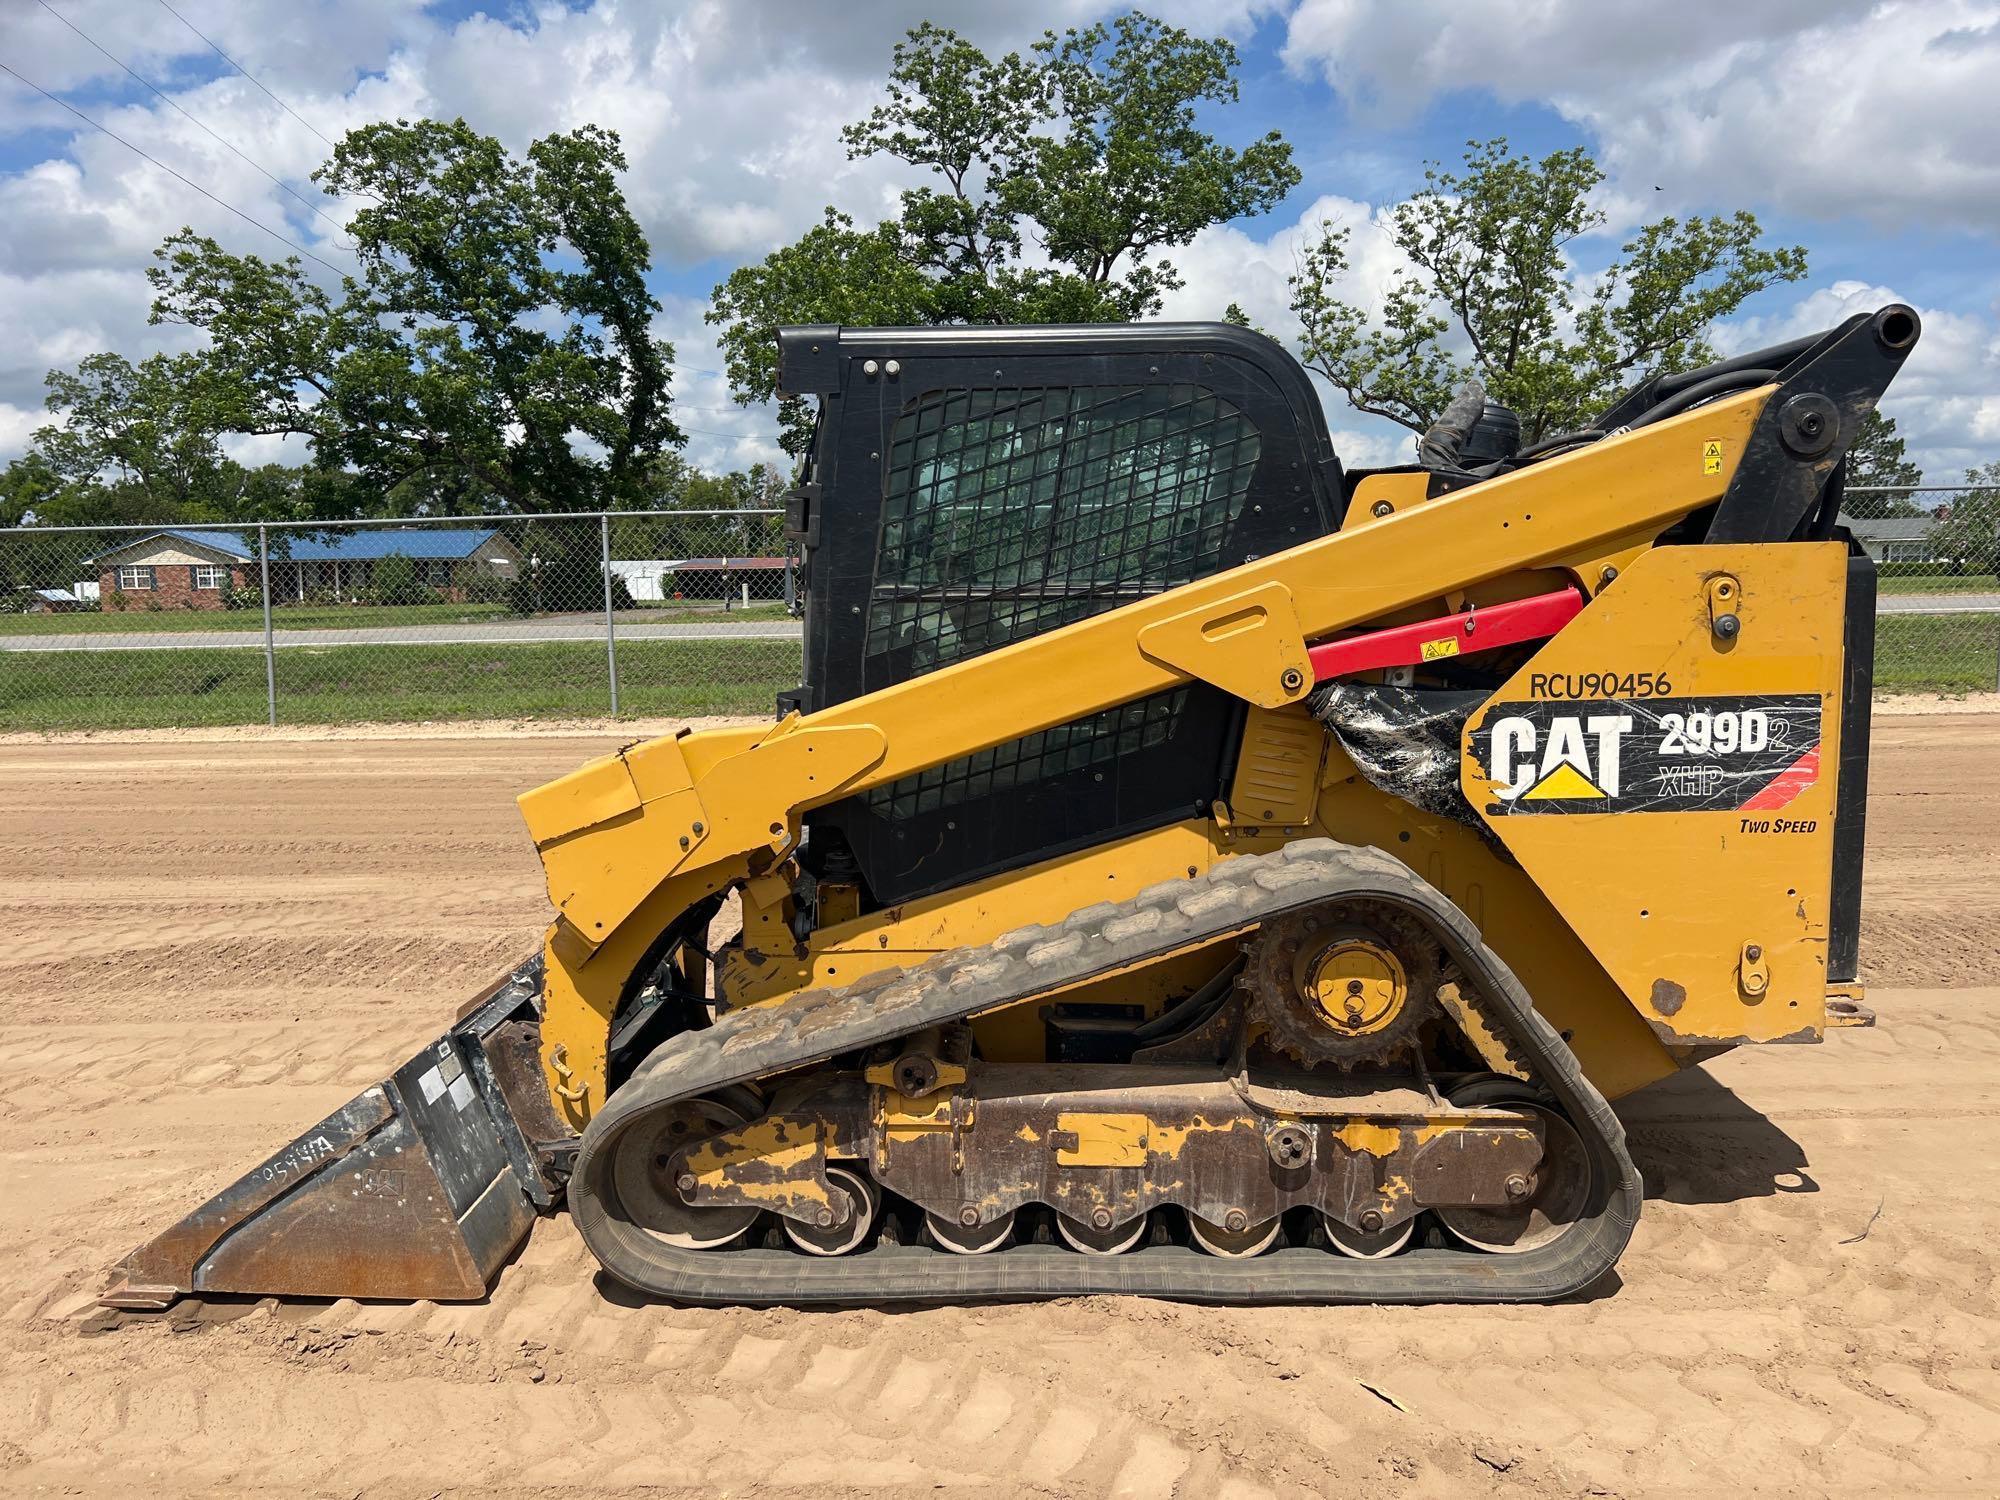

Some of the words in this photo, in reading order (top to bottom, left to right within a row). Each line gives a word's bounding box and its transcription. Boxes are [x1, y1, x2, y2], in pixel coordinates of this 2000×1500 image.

[1530, 671, 1672, 699] RCU90456
[1490, 715, 1633, 801] CAT
[1658, 765, 1724, 797] XHP
